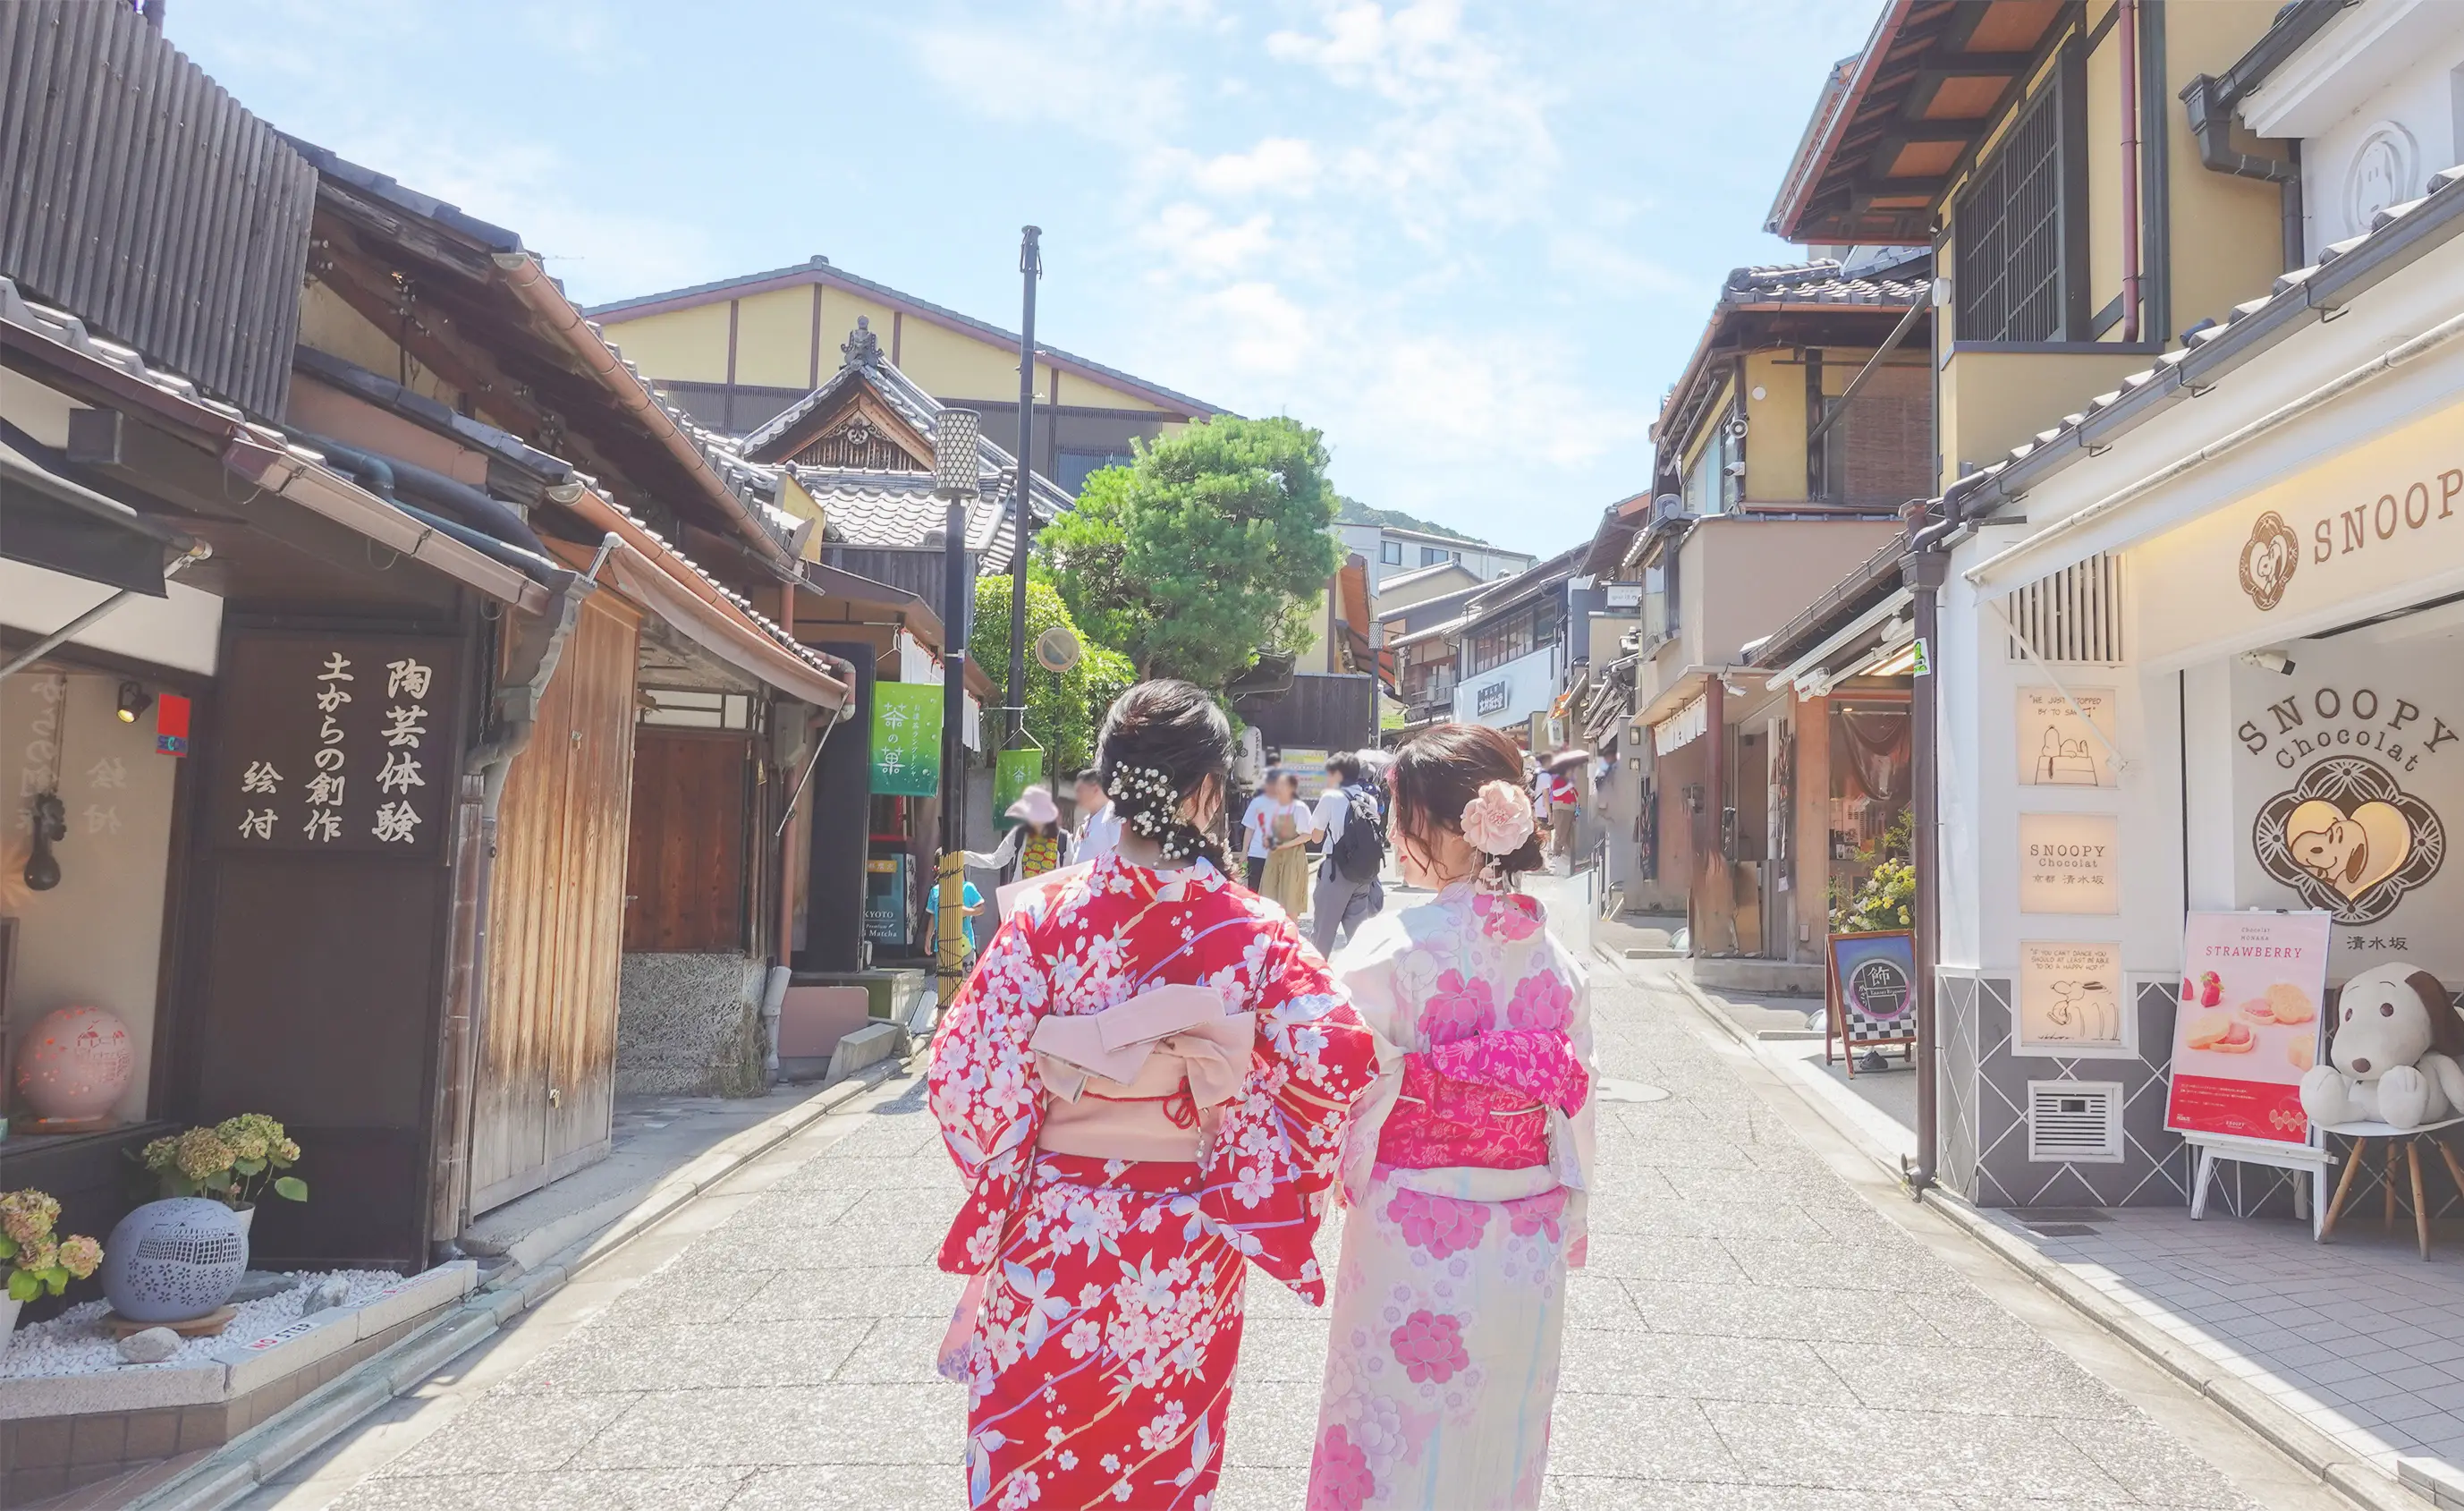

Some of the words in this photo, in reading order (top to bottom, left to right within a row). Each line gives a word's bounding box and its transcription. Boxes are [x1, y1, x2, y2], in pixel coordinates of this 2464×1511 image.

[2314, 468, 2464, 565] SNOOP
[2238, 688, 2460, 755] SNOOPY
[303, 652, 354, 843] 土からの創作
[372, 658, 432, 844] 陶芸体験
[876, 701, 910, 776] 茶の菓
[2275, 729, 2418, 772] Chocolat
[238, 761, 284, 840] 絵付
[2030, 844, 2106, 857] SNOOPY
[2038, 858, 2098, 868] Chocolat
[2033, 874, 2055, 884] 京都
[2062, 874, 2104, 885] 清水坂
[2206, 946, 2302, 958] STRAWBERRY
[2346, 935, 2409, 951] 清水坂
[1867, 965, 1891, 987] 飾
[251, 1338, 278, 1349] NO
